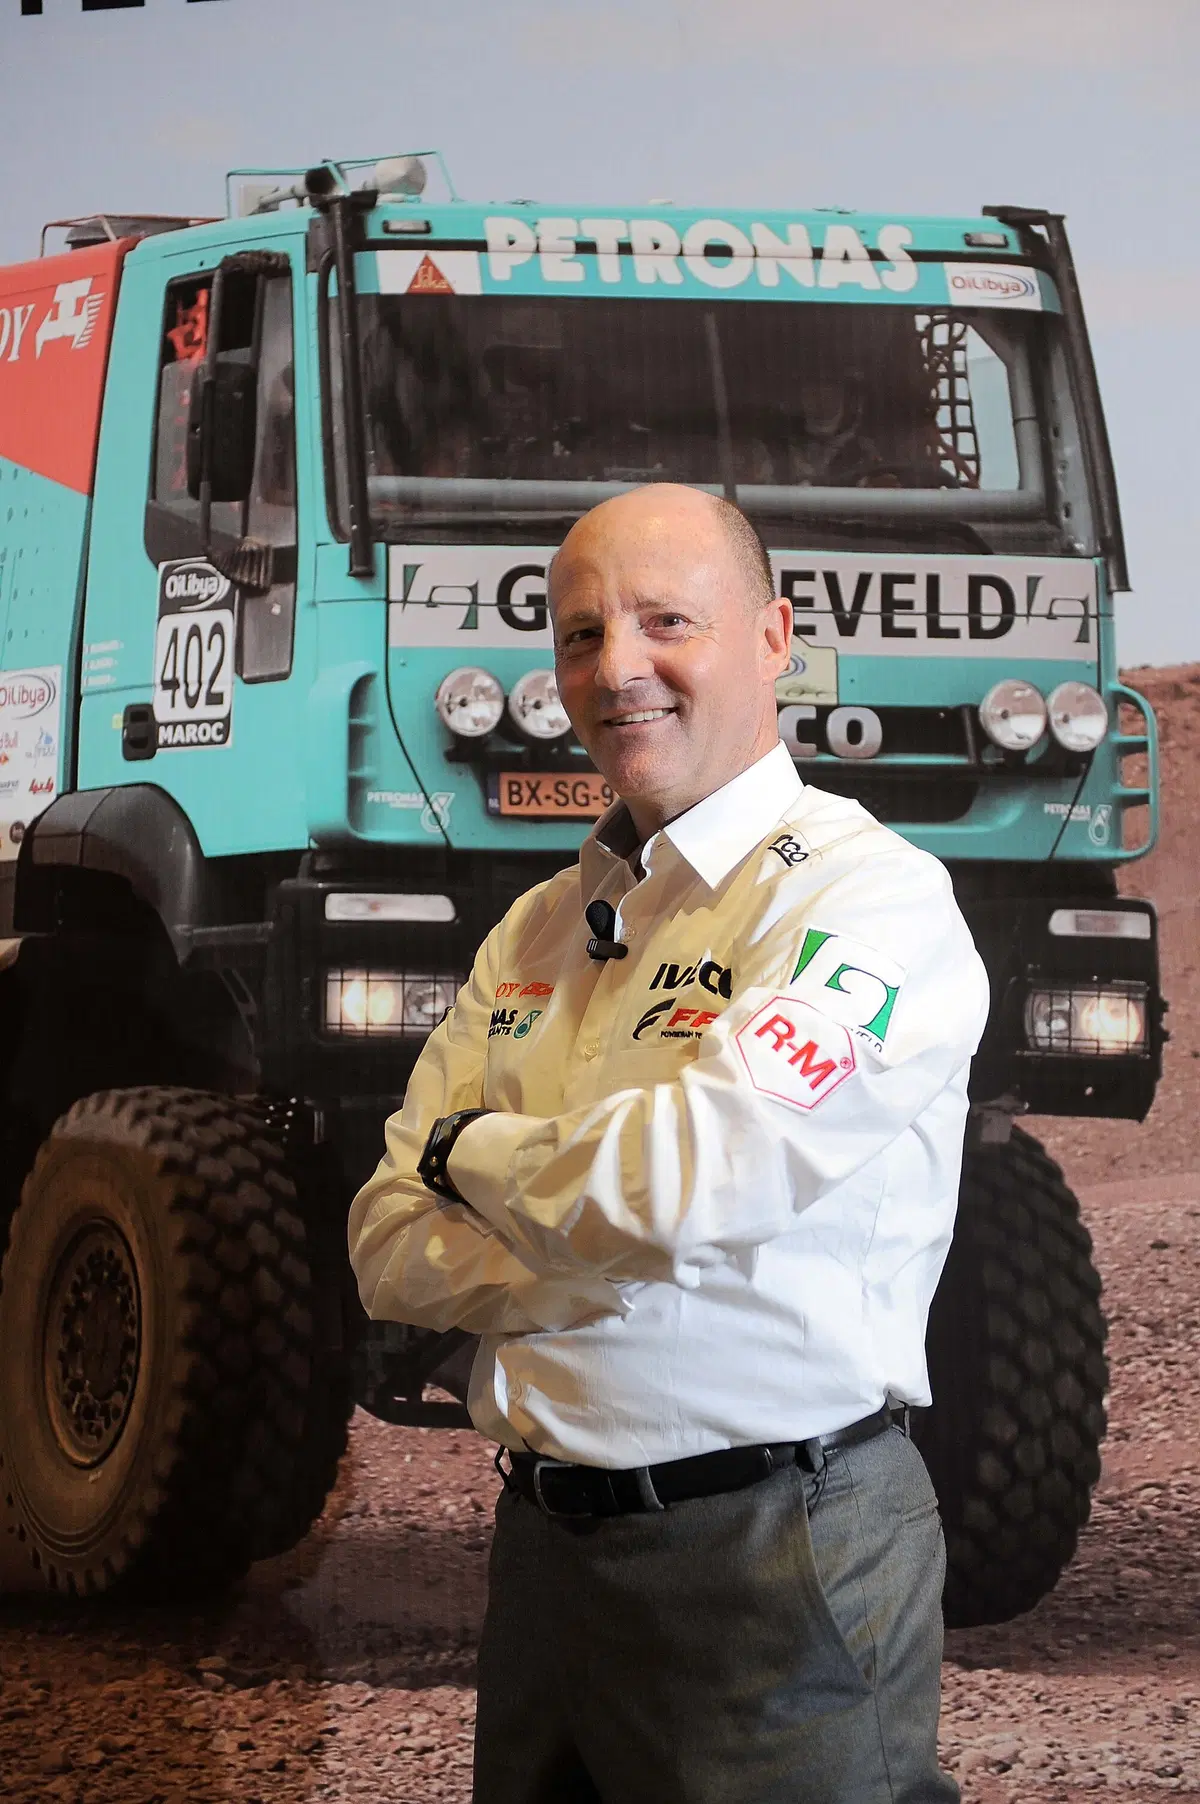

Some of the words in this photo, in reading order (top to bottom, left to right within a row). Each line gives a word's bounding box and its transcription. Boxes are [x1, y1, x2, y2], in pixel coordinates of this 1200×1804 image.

[484, 216, 919, 293] PETRONAS
[951, 274, 1023, 294] OiLibya
[165, 572, 219, 601] OiLibya
[160, 621, 226, 710] 402
[158, 721, 225, 744] MAROC
